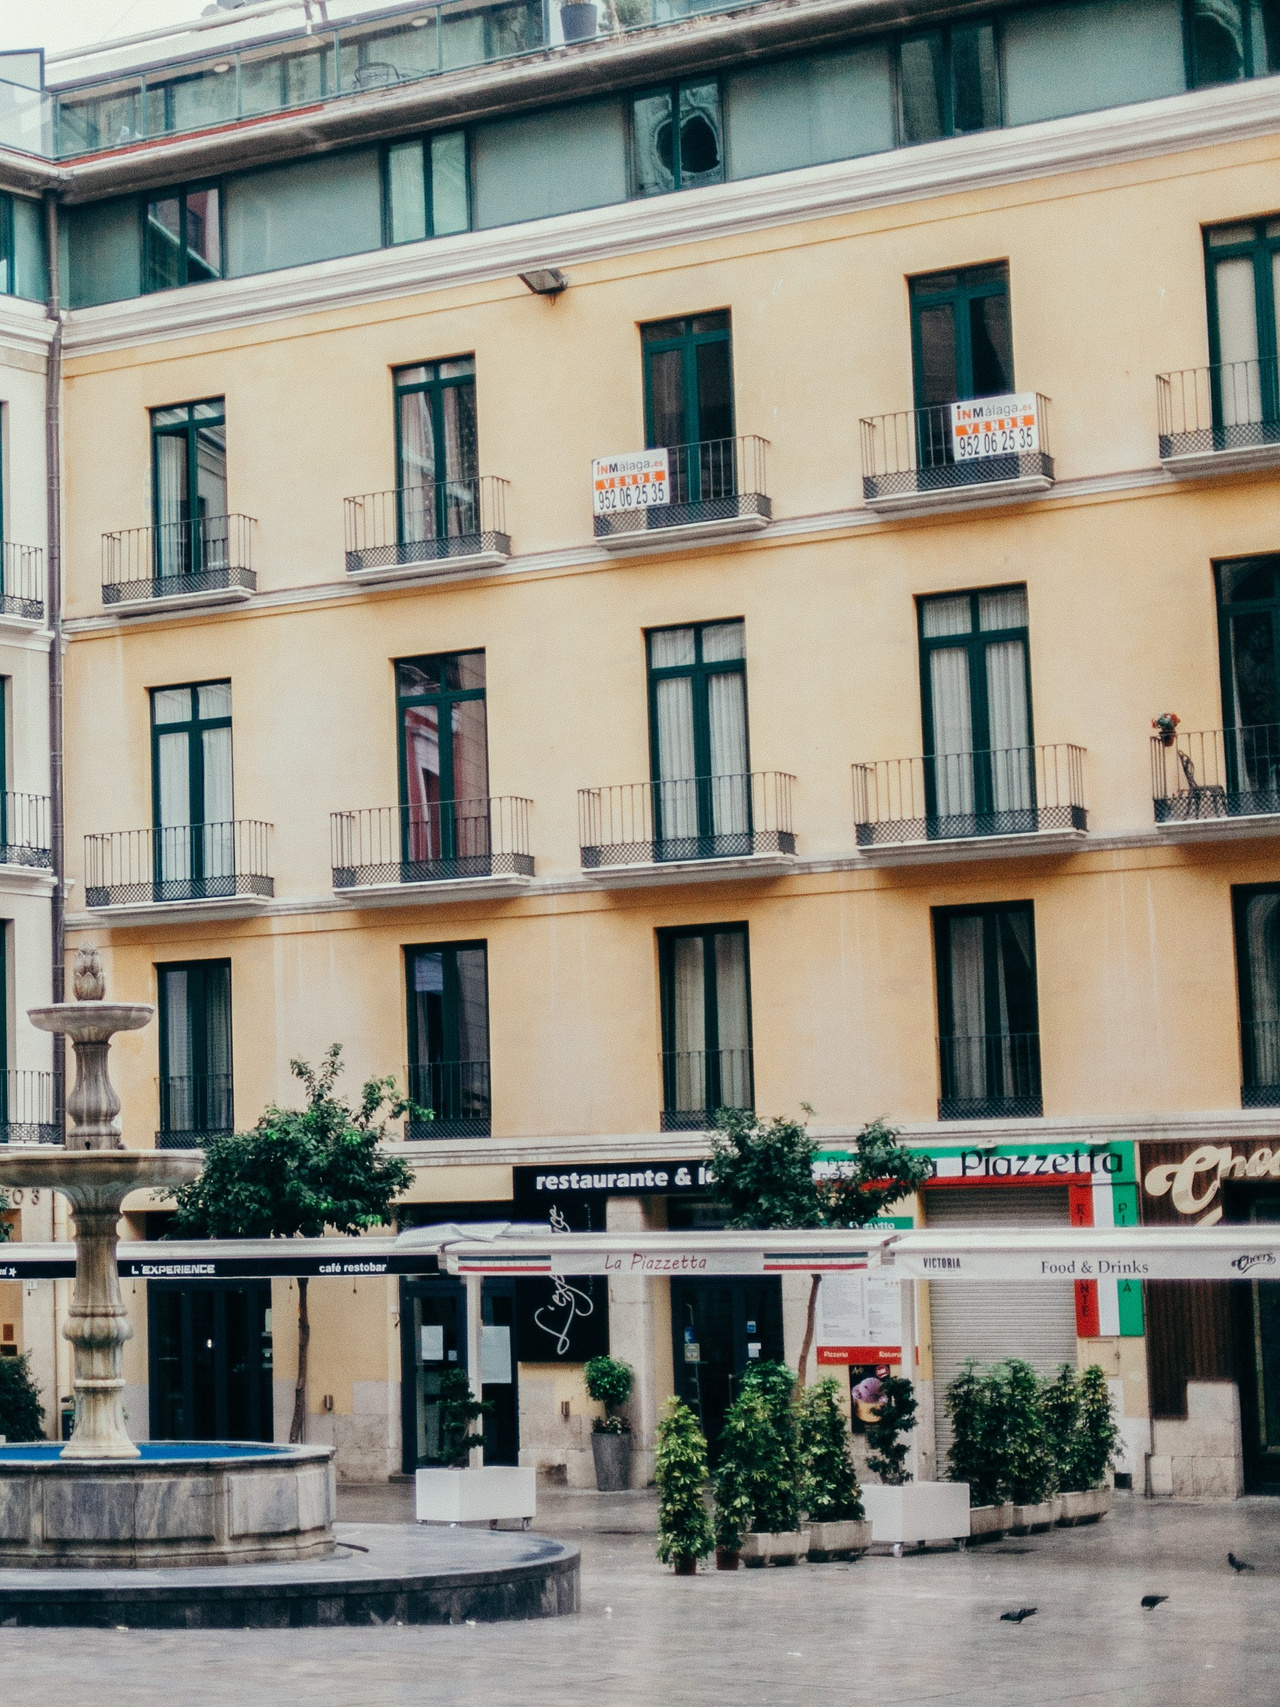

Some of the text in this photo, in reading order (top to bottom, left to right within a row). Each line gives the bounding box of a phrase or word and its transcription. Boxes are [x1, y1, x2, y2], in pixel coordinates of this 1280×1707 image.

[966, 416, 1024, 434] VENDE
[959, 427, 1033, 457] 952 06 25 35
[603, 472, 656, 489] VENDE
[598, 482, 664, 510] 952 06 25 35
[961, 1144, 1123, 1177] Piazzetta
[536, 1169, 669, 1190] restaurante
[675, 1167, 692, 1186] &
[319, 1262, 387, 1273] café restobar
[605, 1253, 707, 1270] La Piazzetta
[923, 1257, 961, 1269] VICTORIA
[1041, 1260, 1149, 1273] Food & Drinks
